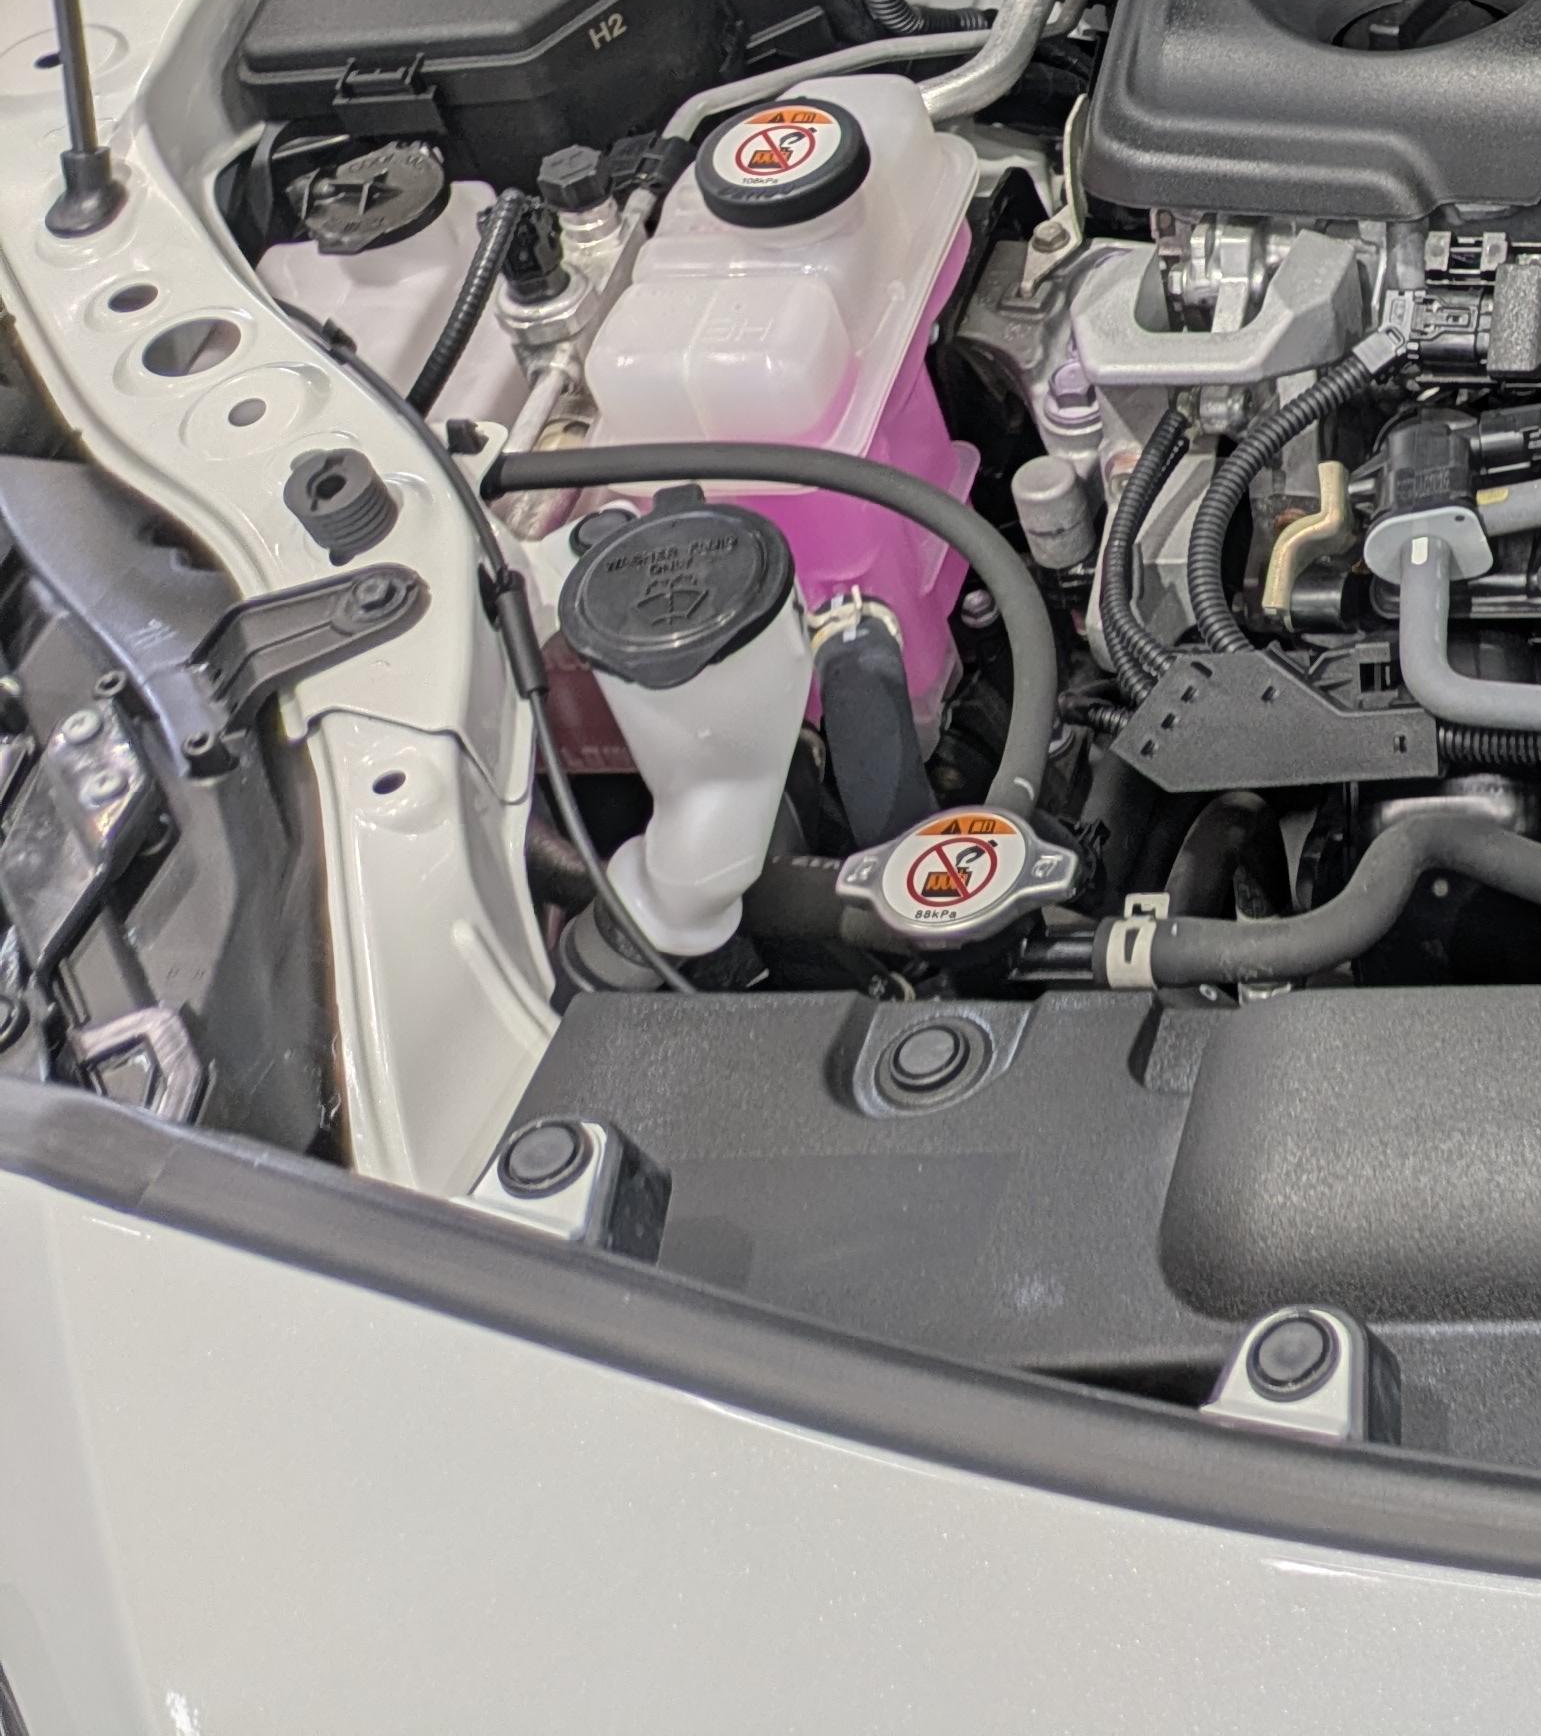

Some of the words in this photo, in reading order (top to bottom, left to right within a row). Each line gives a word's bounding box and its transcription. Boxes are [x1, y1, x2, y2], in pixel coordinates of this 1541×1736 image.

[588, 12, 628, 50] H2
[741, 176, 780, 186] 108kPa
[606, 546, 679, 574] WASHER
[688, 534, 740, 558] FLUID
[648, 557, 695, 577] ONLY
[913, 909, 958, 920] 88kPa
